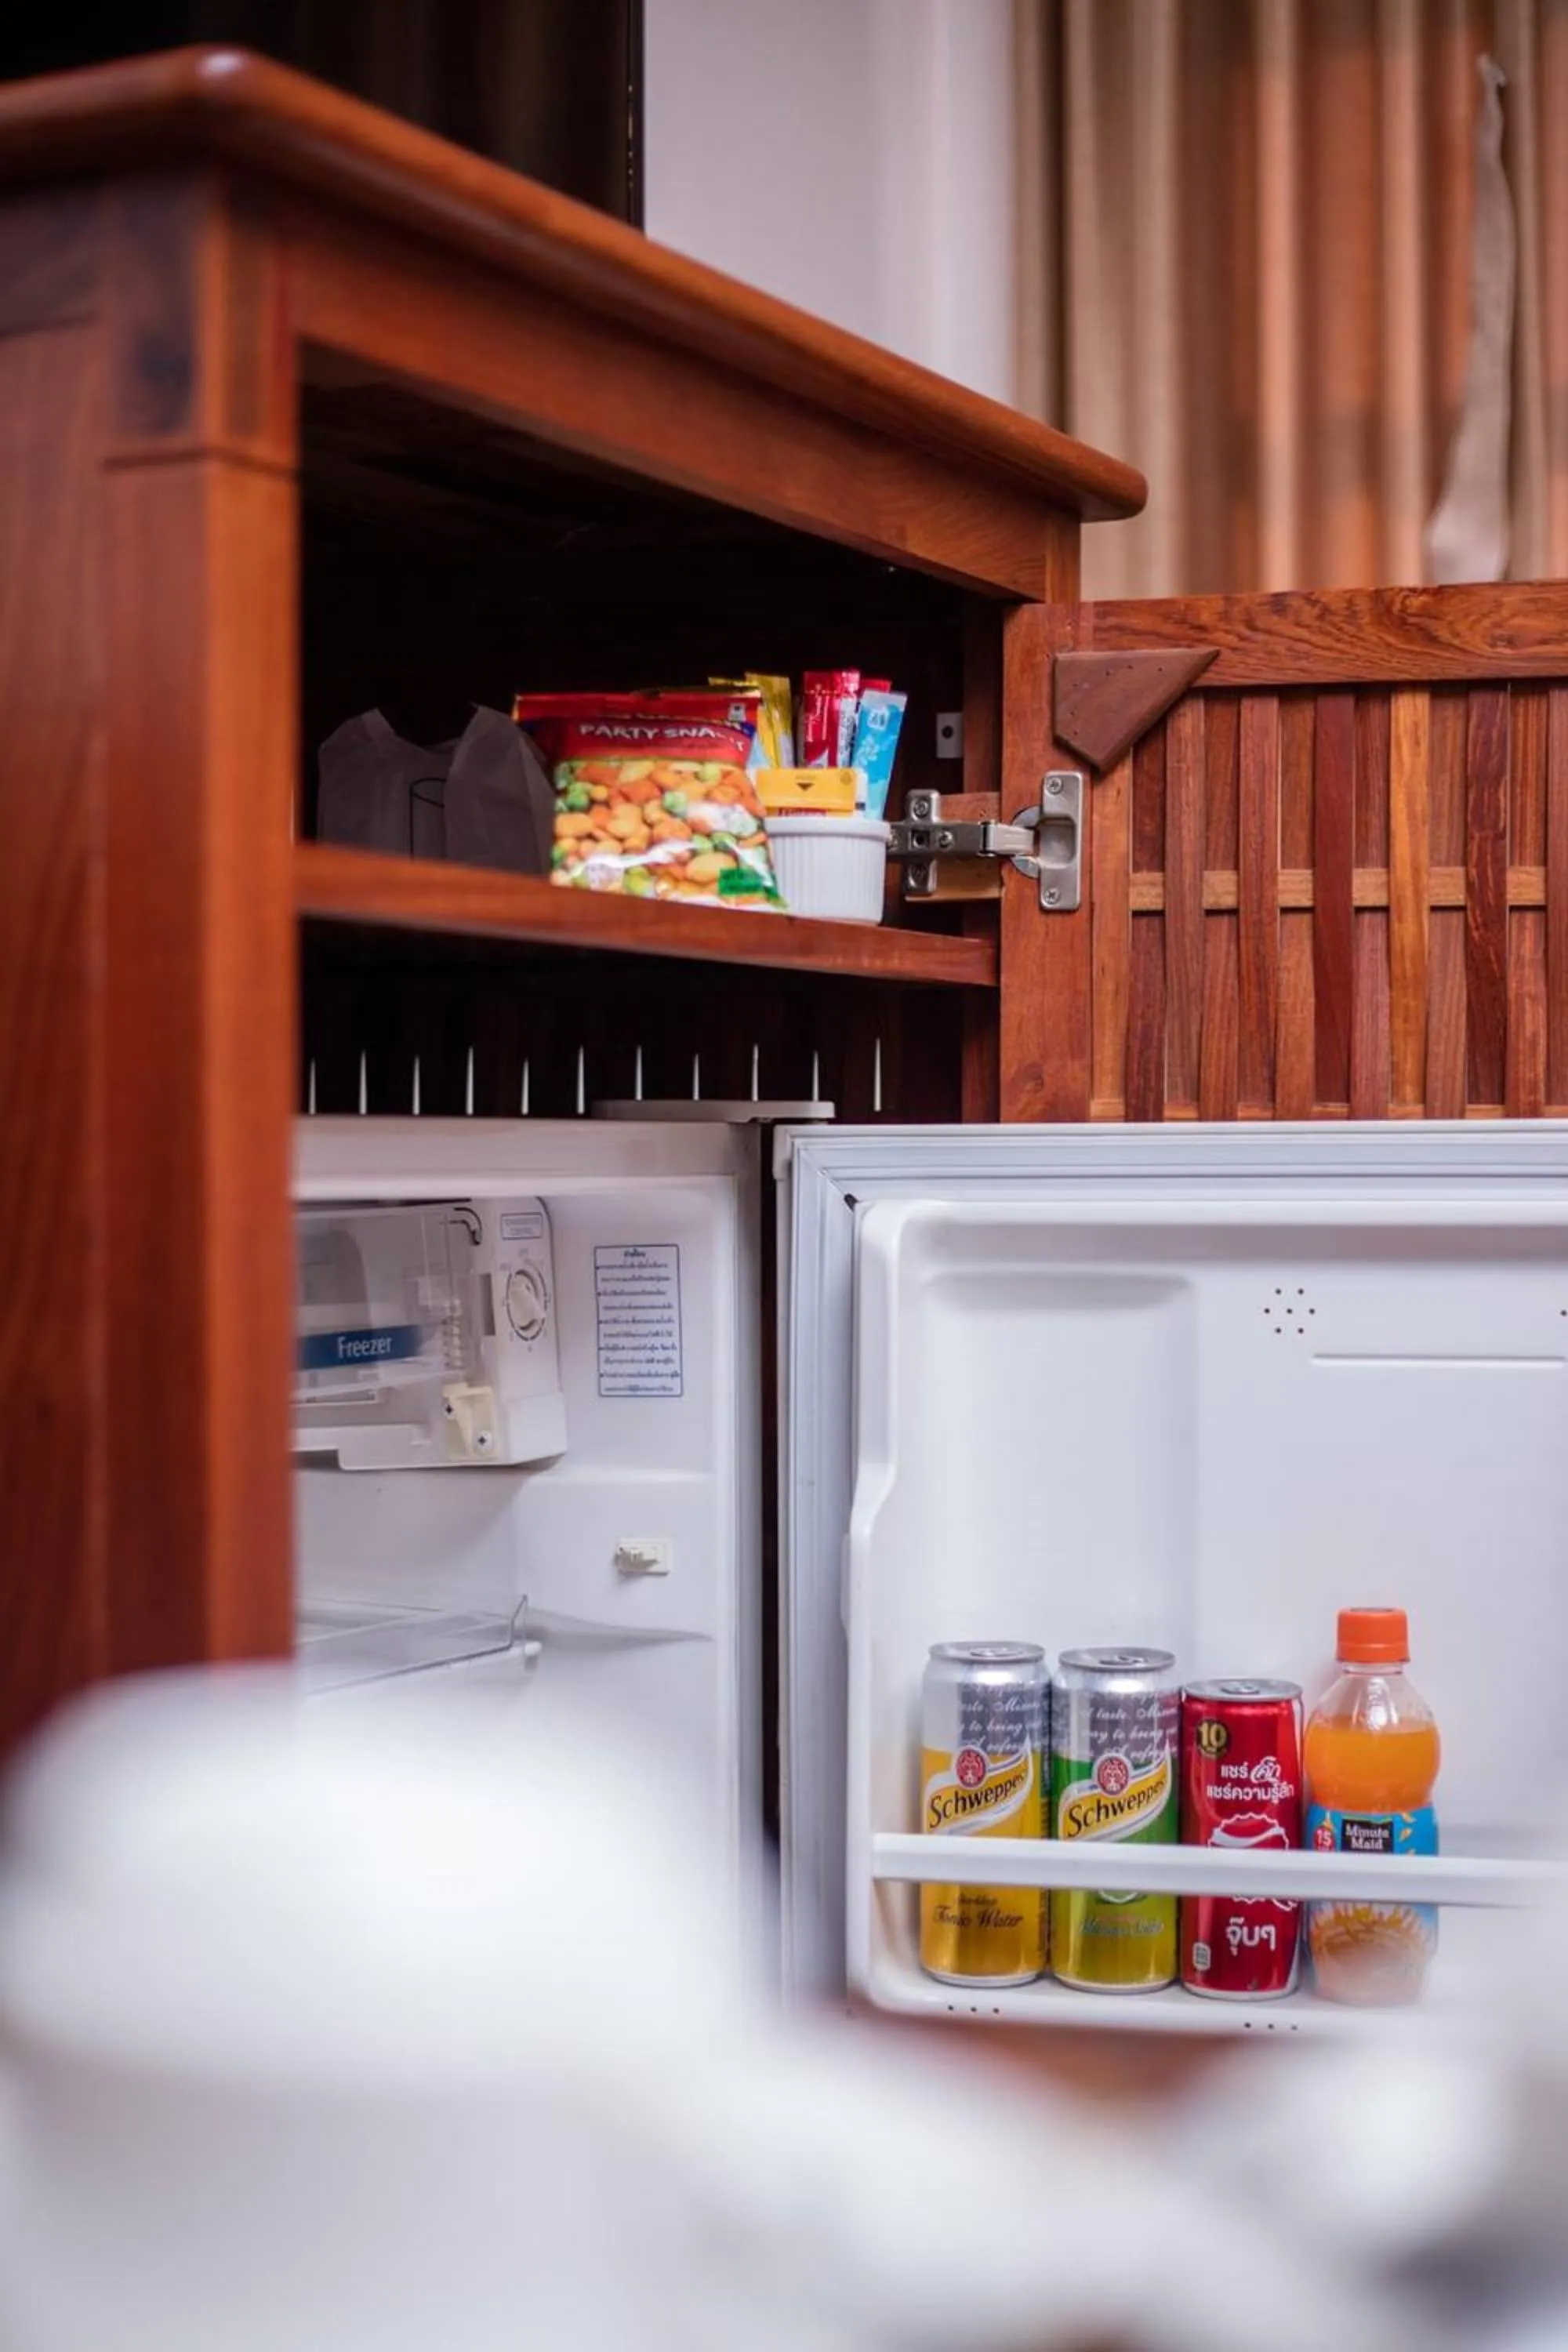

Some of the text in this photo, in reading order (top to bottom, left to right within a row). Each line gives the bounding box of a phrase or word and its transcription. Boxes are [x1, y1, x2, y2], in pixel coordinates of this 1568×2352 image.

[579, 723, 659, 740] PARTY
[337, 1335, 394, 1359] Freezer
[1197, 1722, 1227, 1748] 10
[1221, 1761, 1249, 1779] แชร์
[928, 1772, 1025, 1829] Schweppes
[1206, 1781, 1294, 1805] แชร์ความรู้สึก
[1316, 1829, 1332, 1847] 15
[1345, 1823, 1390, 1838] Minute
[1351, 1836, 1384, 1850] Maid
